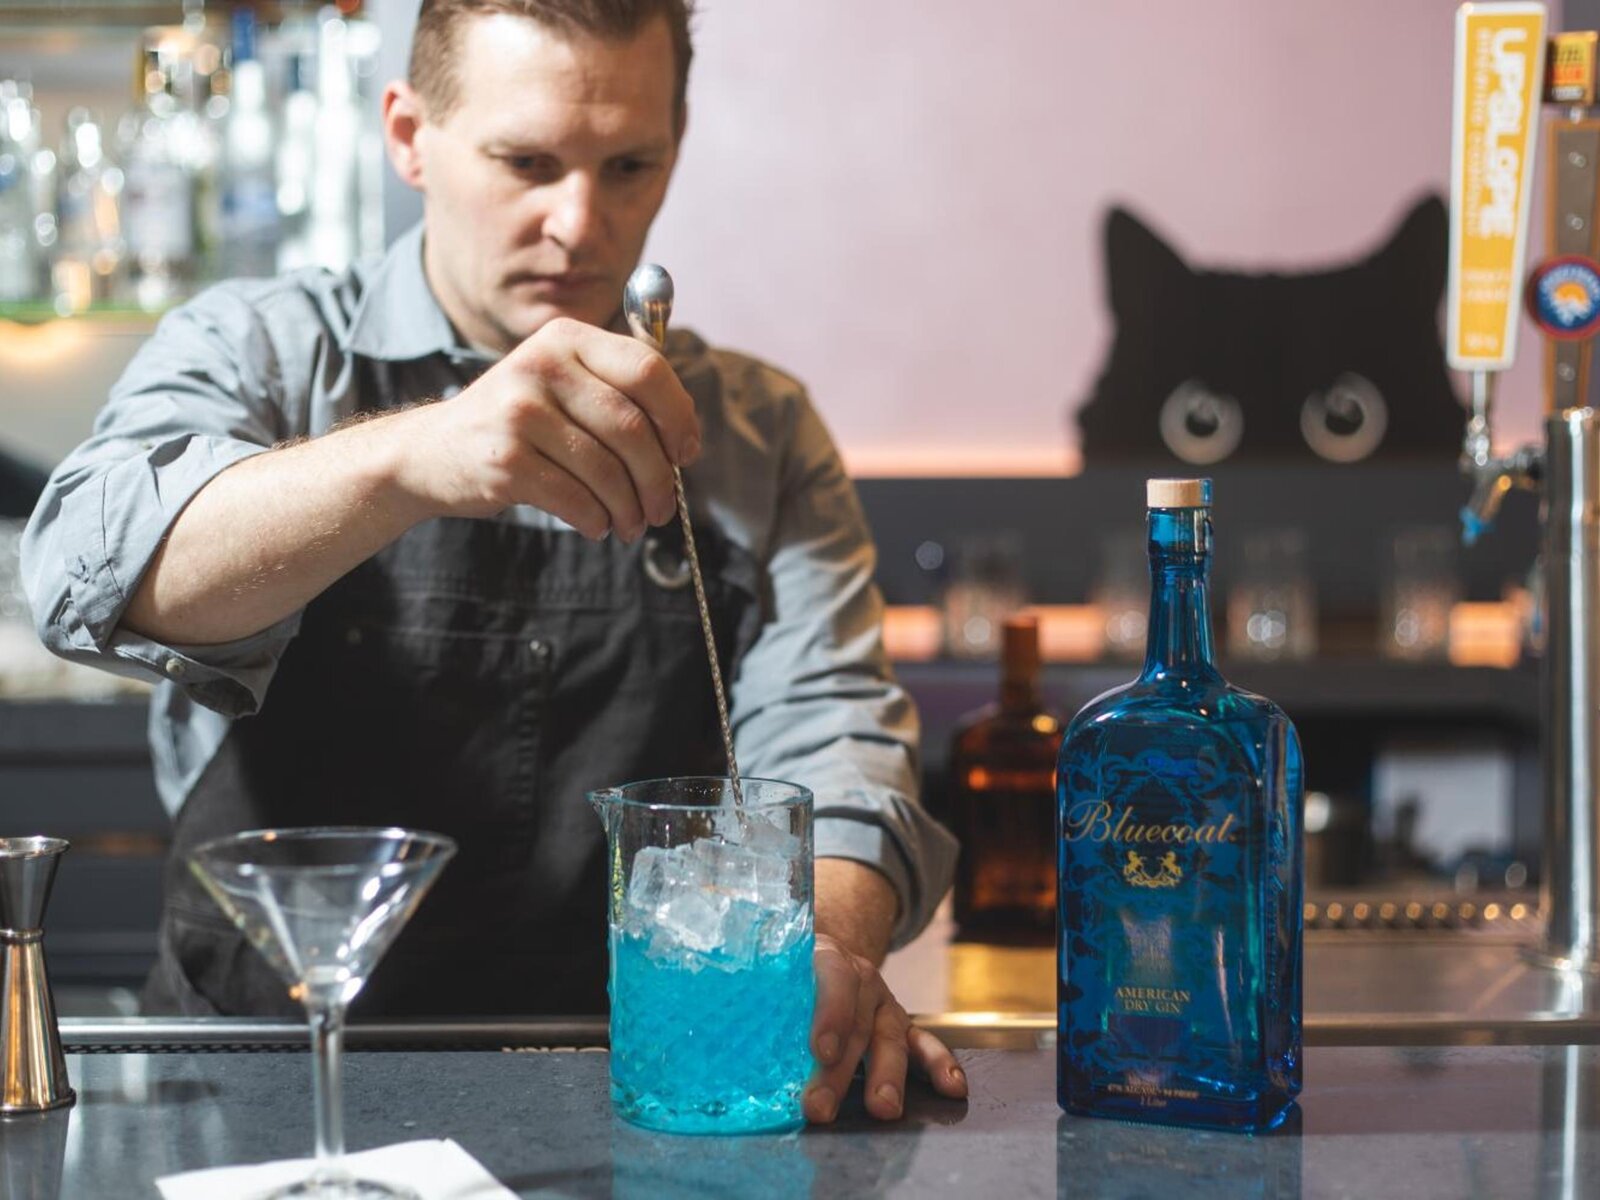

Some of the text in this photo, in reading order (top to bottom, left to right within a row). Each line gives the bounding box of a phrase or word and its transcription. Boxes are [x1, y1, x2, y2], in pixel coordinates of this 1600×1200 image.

[1479, 26, 1528, 239] UPSLOPE
[1065, 799, 1235, 843] Bluecoat
[1115, 986, 1191, 1002] AMERICAN
[1123, 999, 1181, 1014] DRY GIN
